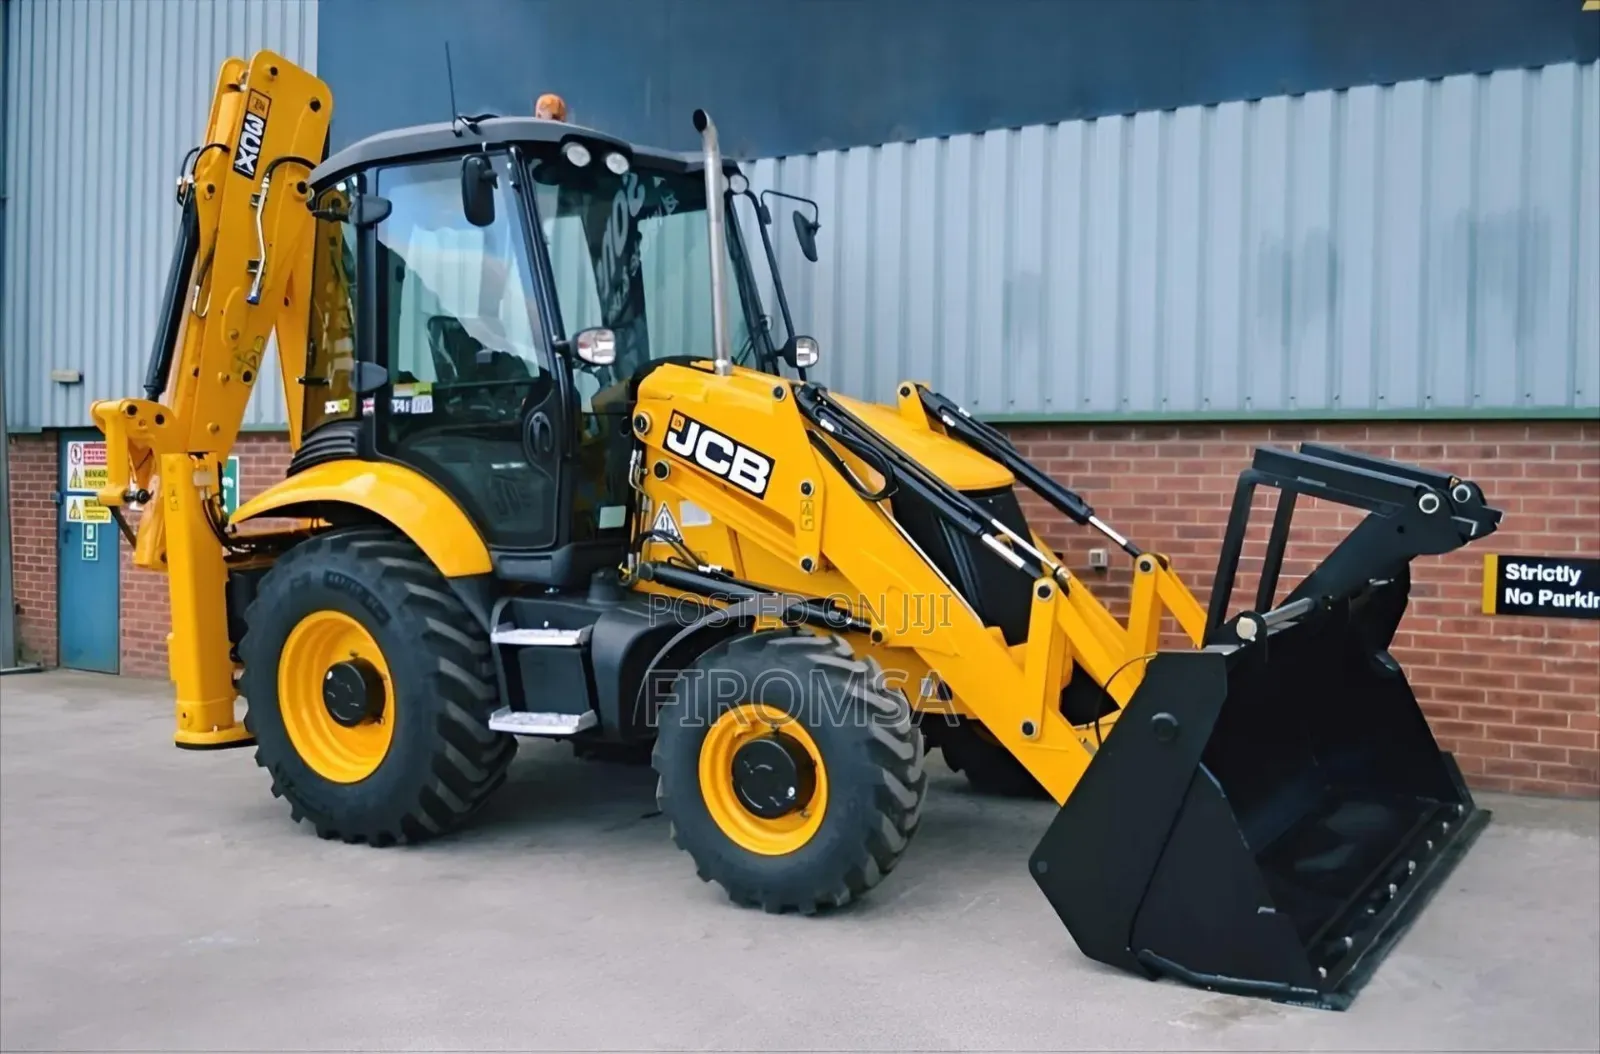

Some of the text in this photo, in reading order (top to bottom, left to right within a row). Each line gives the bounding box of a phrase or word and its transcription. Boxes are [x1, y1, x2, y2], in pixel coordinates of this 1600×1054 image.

[666, 421, 770, 495] JCB
[1505, 563, 1582, 587] Strictly
[1504, 588, 1534, 605] No
